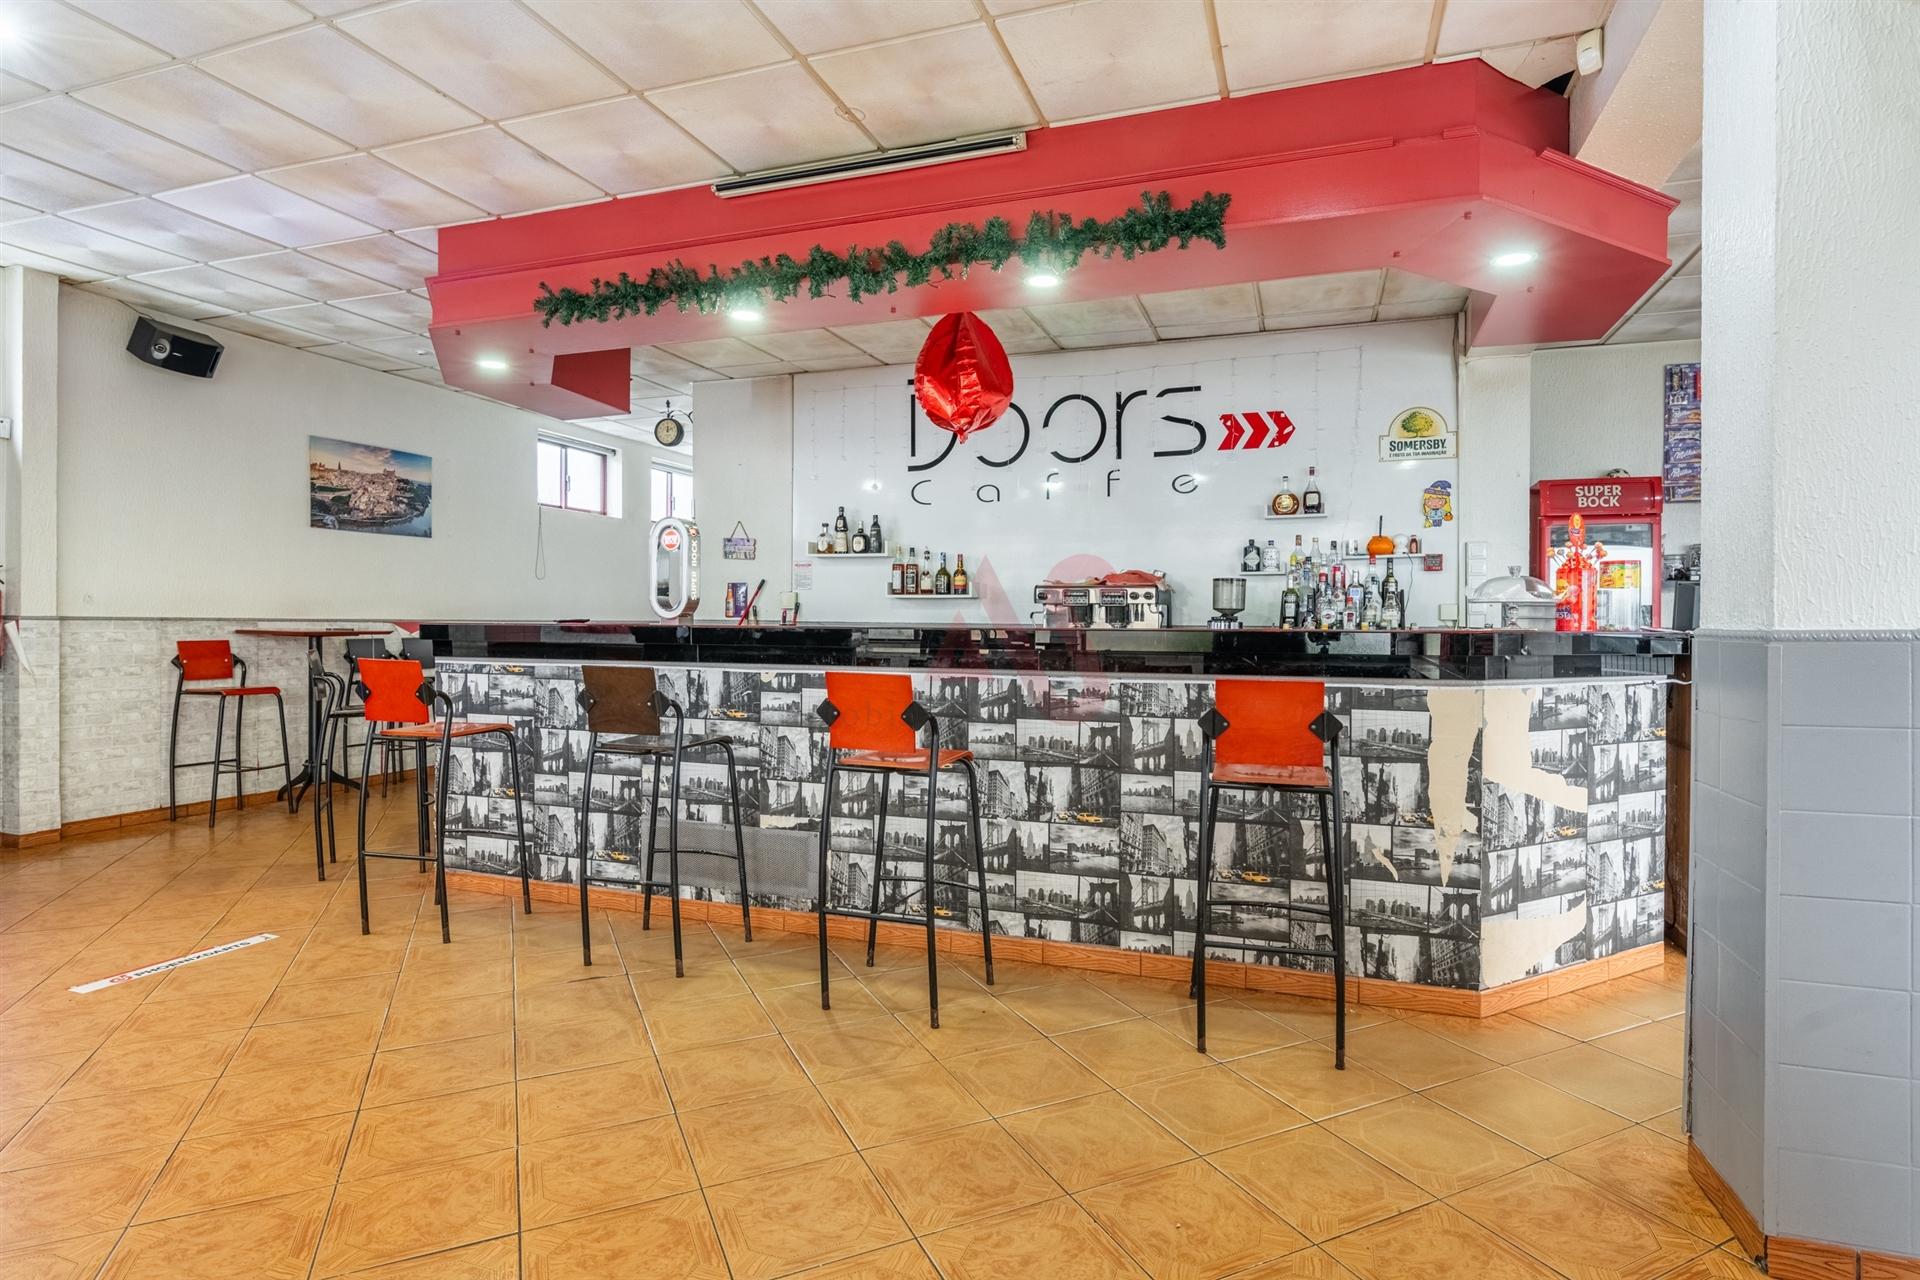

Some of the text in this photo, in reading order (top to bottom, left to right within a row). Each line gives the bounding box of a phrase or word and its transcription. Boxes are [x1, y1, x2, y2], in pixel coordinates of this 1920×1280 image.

[1389, 439, 1447, 452] SOMERSBY
[1575, 485, 1622, 497] SUPER
[1577, 496, 1620, 508] BOCK
